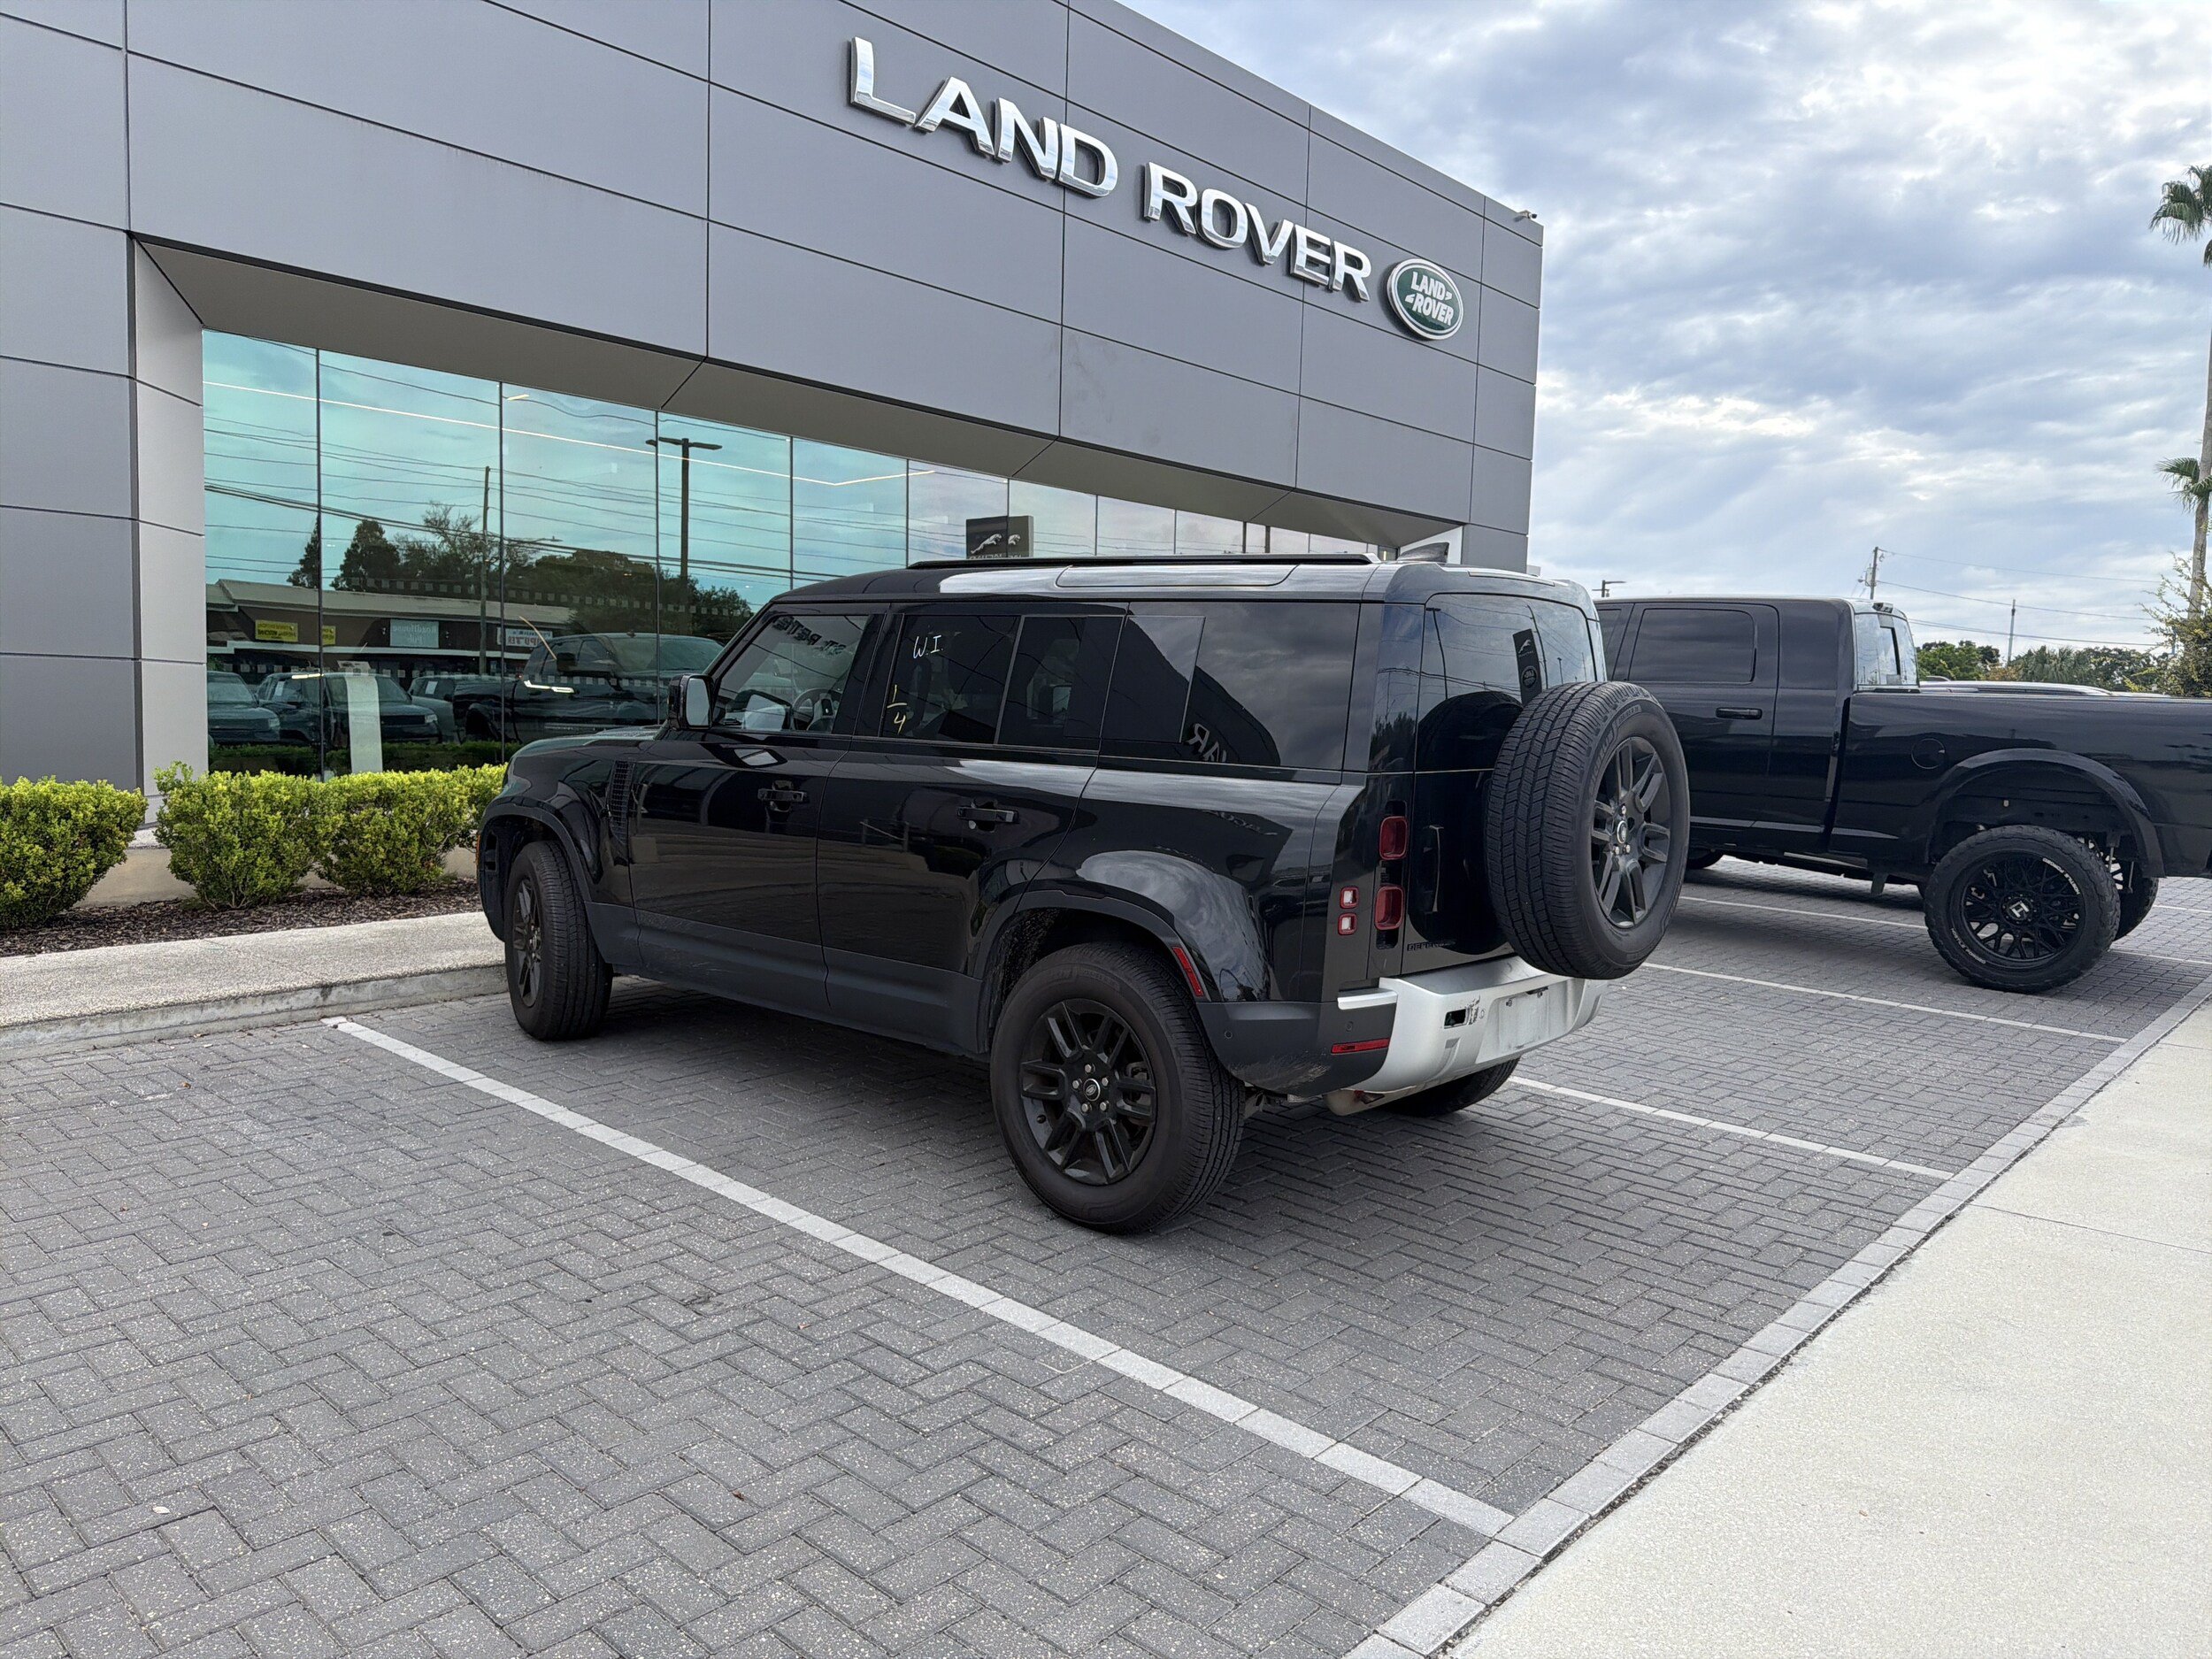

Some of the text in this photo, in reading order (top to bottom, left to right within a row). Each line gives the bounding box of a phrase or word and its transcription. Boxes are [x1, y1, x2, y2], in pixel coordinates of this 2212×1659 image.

[849, 36, 1371, 302] LAND ROVER
[1410, 271, 1446, 301] LAND
[1411, 292, 1455, 326] ROVER
